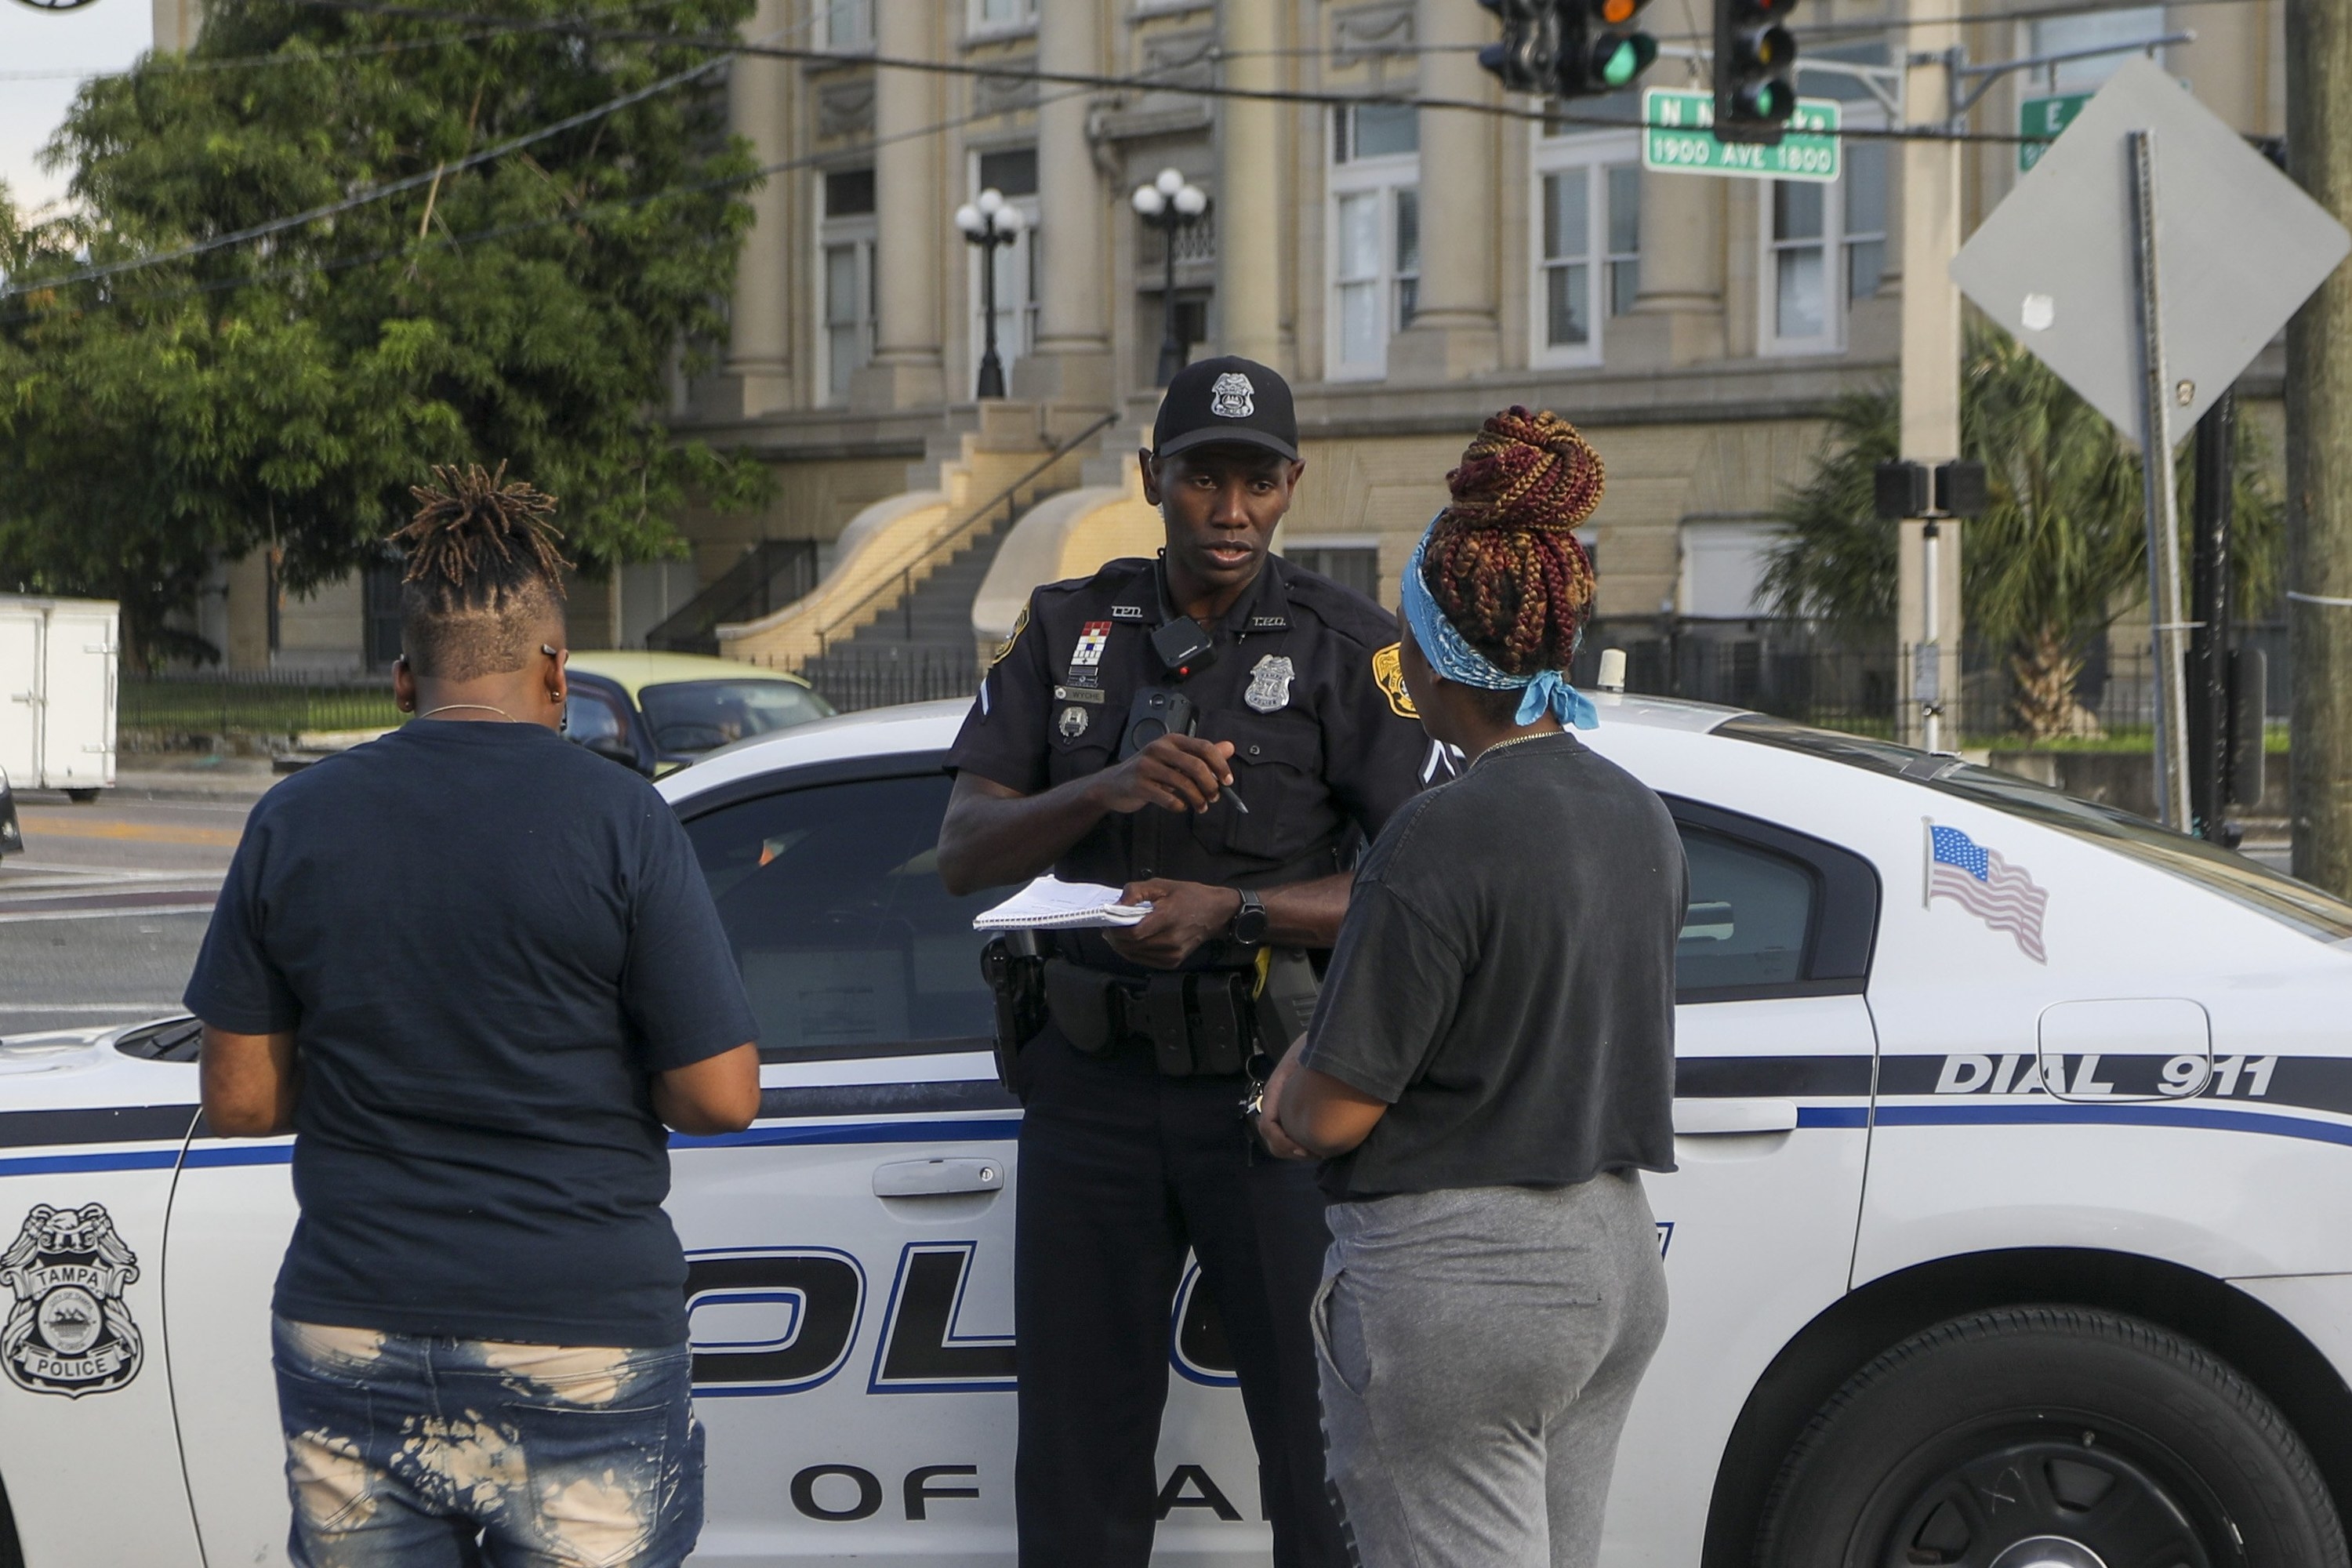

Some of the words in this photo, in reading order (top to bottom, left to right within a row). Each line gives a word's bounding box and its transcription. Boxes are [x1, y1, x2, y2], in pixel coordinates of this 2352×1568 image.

[1660, 99, 1681, 127] N
[2045, 100, 2063, 132] E
[1653, 137, 1710, 164] 1900
[1720, 142, 1766, 169] AVE
[1777, 144, 1832, 172] 1800
[1934, 1054, 2115, 1094] DIAL
[2158, 1054, 2279, 1097] 911
[36, 1267, 100, 1287] TAMPA
[37, 1358, 107, 1377] POLICE
[789, 1463, 980, 1522] OF
